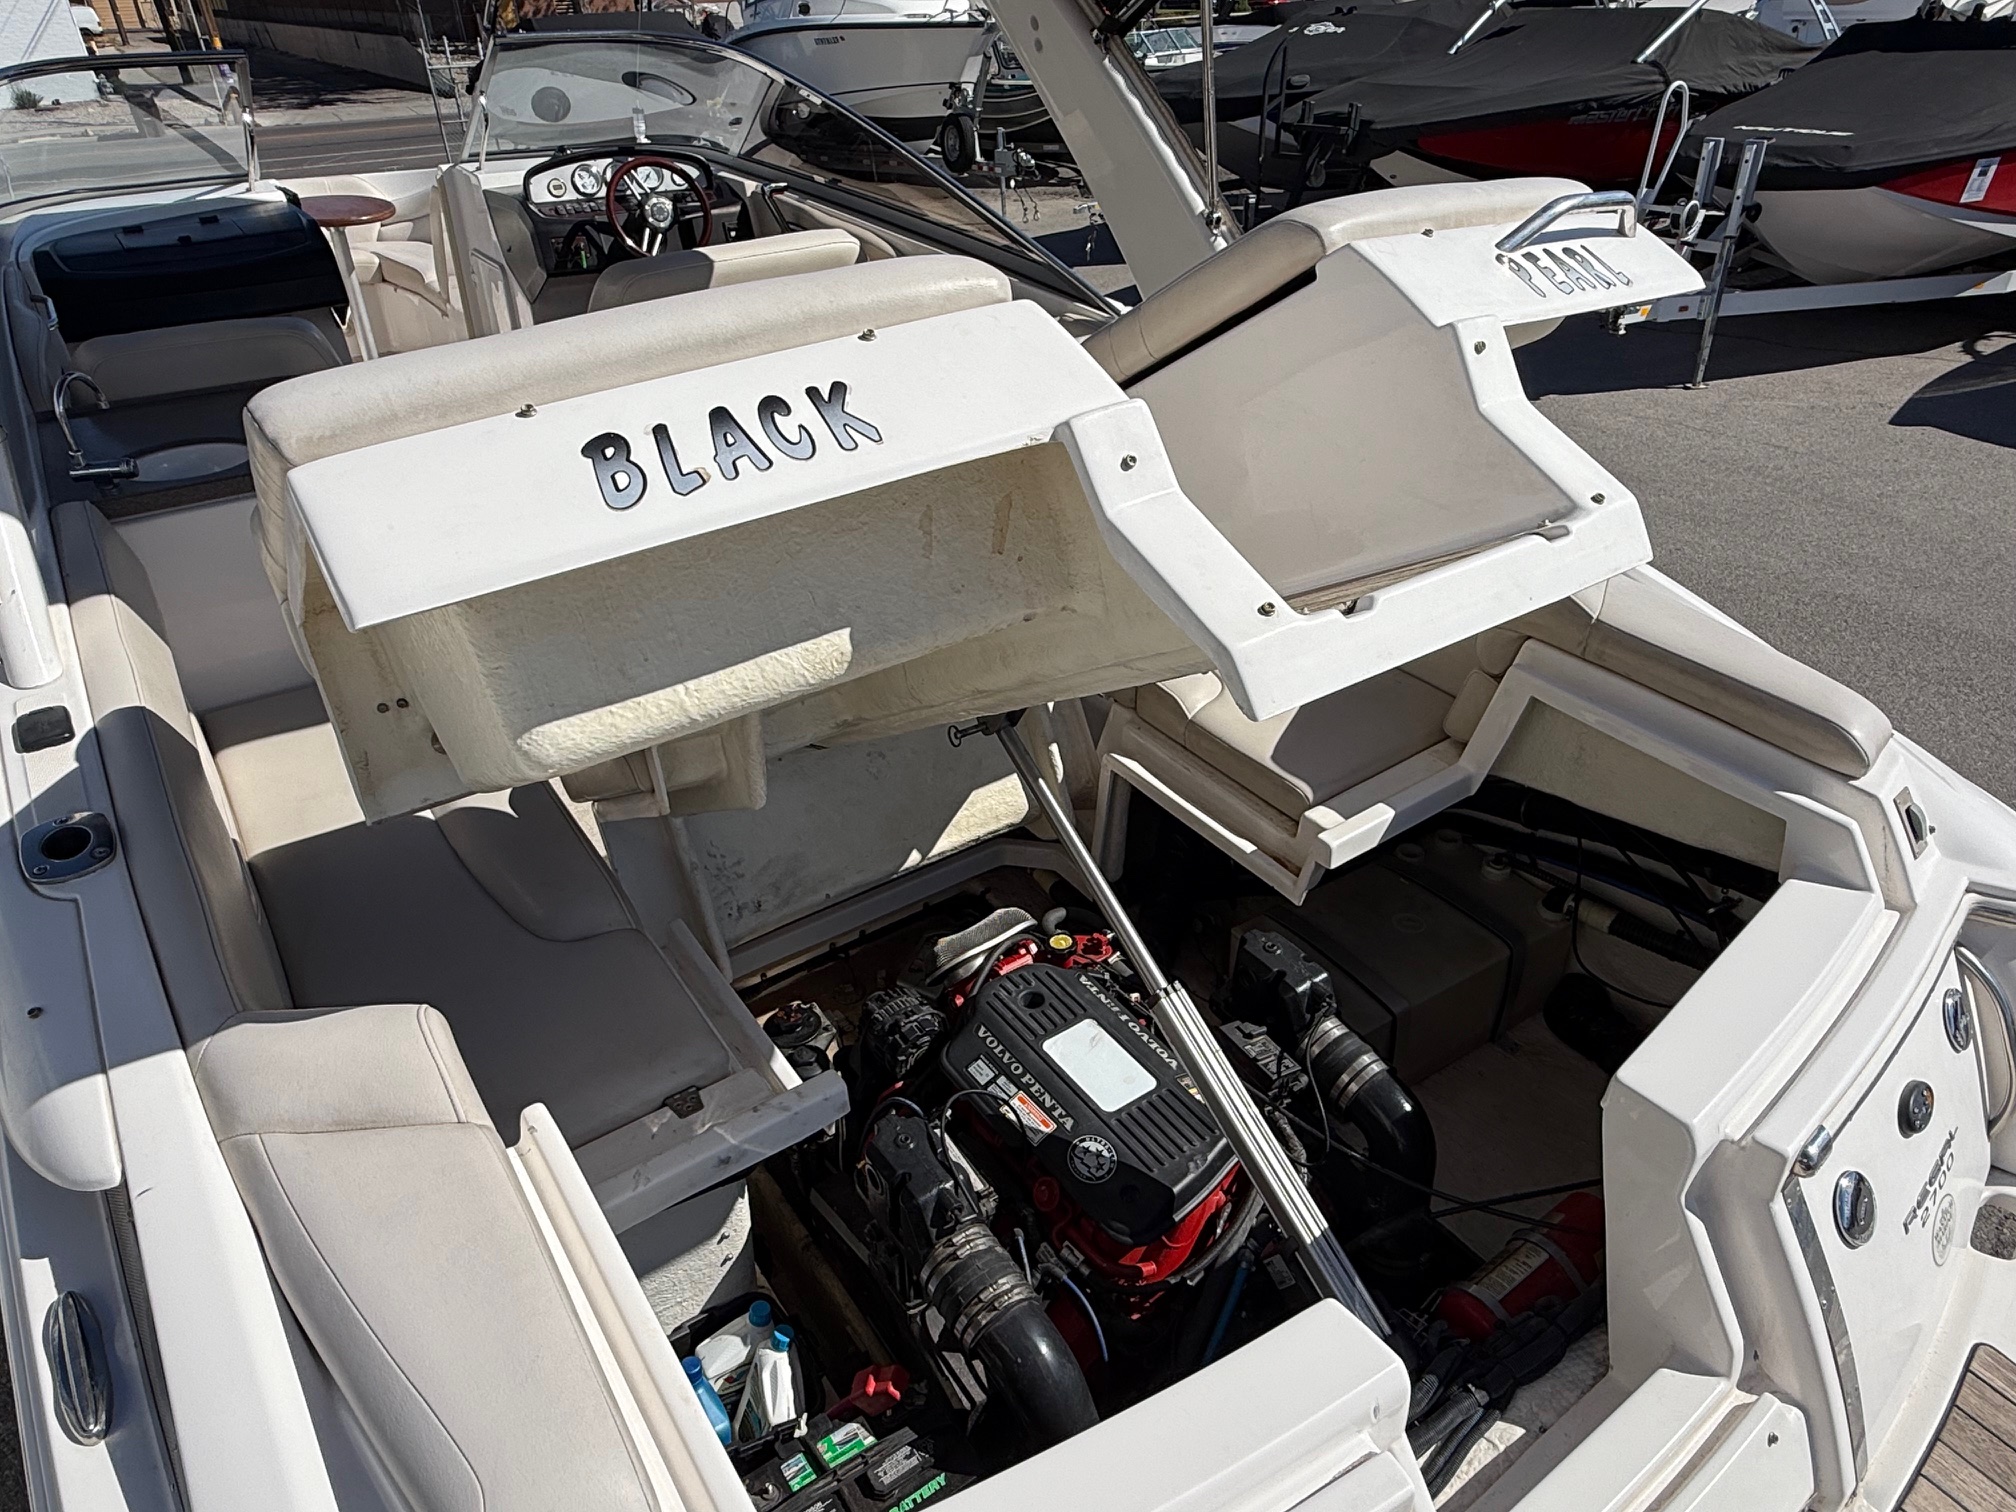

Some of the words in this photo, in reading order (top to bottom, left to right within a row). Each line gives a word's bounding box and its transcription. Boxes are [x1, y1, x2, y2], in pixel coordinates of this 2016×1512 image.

[1495, 244, 1631, 298] PEARL
[581, 380, 883, 511] BLACK
[977, 1025, 1023, 1075] VOLVO
[1020, 1073, 1075, 1132] PENTA
[1128, 1021, 1178, 1070] VOLVO
[1902, 1126, 1958, 1235] REGAL
[1920, 1152, 1955, 1228] 2700
